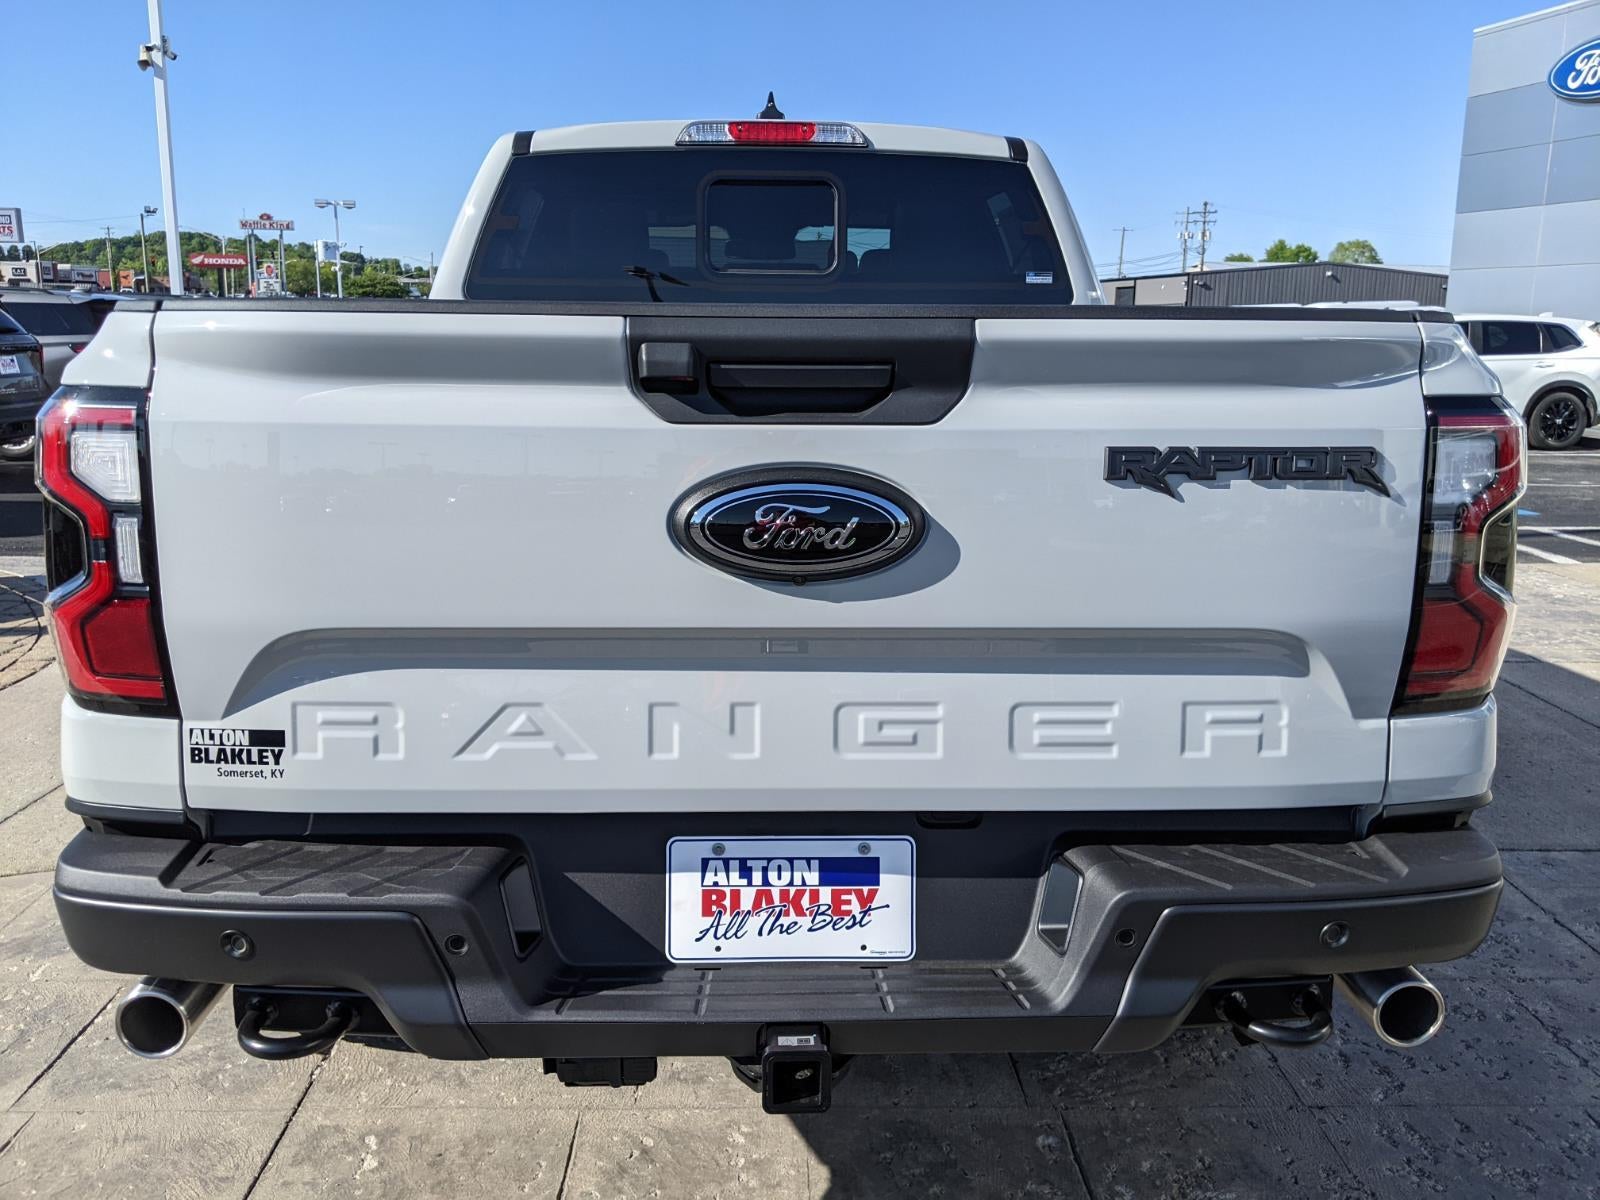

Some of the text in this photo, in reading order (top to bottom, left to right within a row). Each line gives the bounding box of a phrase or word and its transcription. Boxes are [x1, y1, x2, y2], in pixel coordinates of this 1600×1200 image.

[1103, 446, 1391, 498] RAPTOR
[742, 503, 860, 550] Ford
[190, 729, 249, 746] ALTON
[291, 701, 1289, 761] RANGER
[190, 747, 284, 766] BLAKLEY
[217, 767, 285, 780] Somerset, KY
[702, 859, 820, 886] ALTON
[701, 888, 879, 917] BLAKLEY
[695, 903, 890, 942] All The Best
